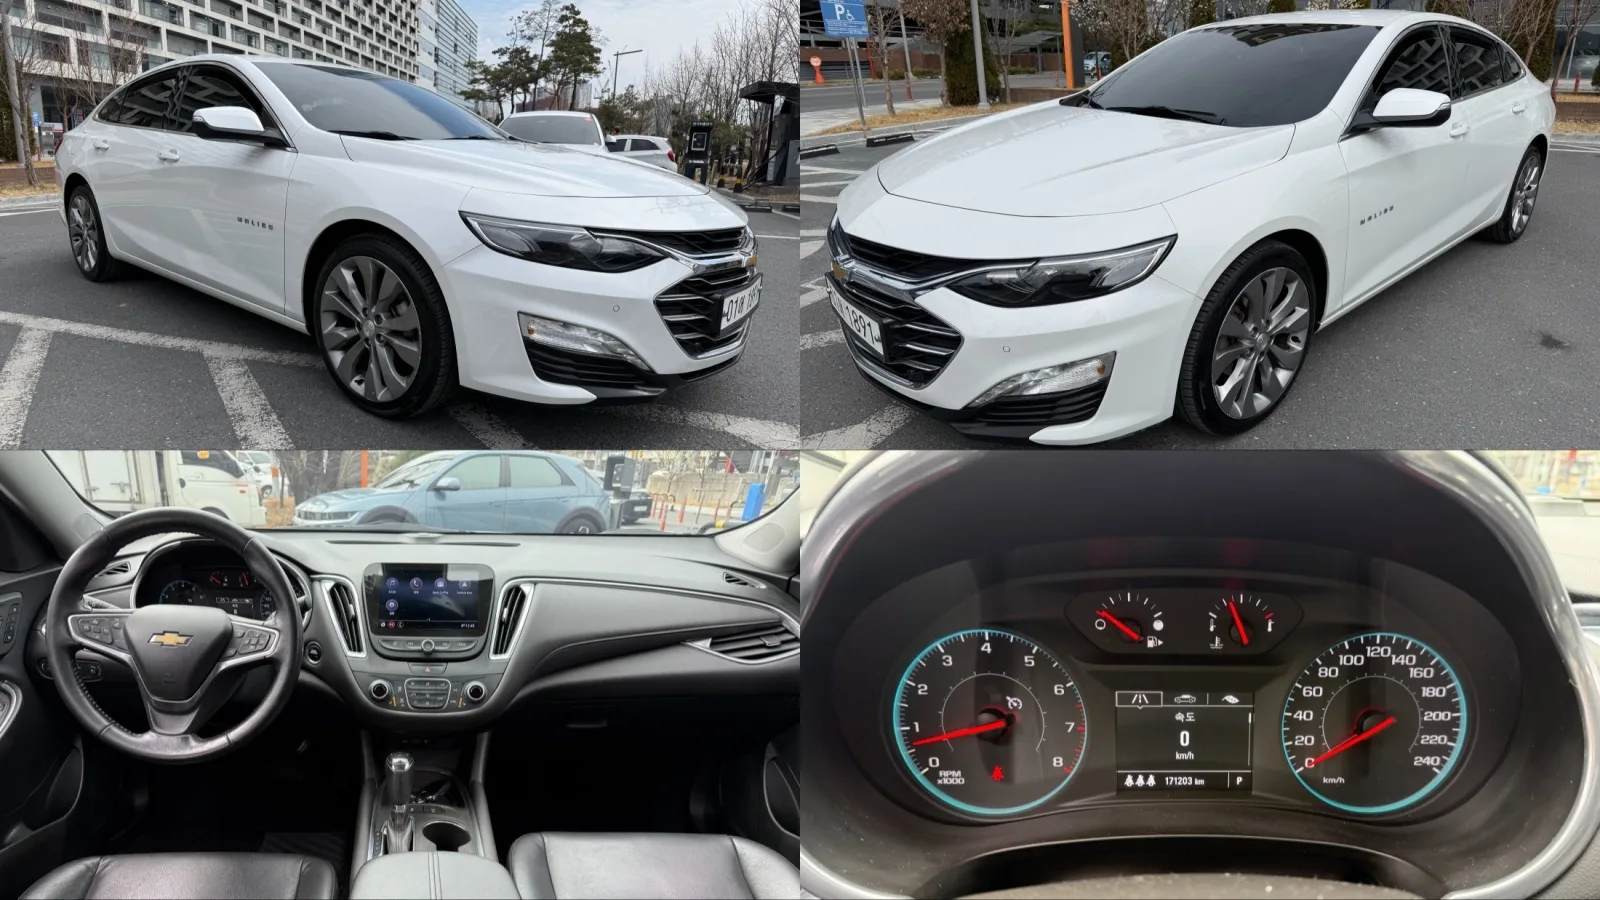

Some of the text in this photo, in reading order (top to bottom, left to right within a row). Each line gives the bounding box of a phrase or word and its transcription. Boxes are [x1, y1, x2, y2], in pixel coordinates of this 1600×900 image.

[834, 4, 845, 20] P
[981, 643, 992, 654] 4
[1366, 646, 1391, 657] 120
[942, 655, 953, 667] 3
[1024, 655, 1035, 667] 5
[1339, 655, 1364, 666] 100
[1391, 655, 1416, 666] 140
[1318, 667, 1339, 678] 80
[1409, 667, 1434, 679] 160
[917, 684, 929, 695] 2
[1053, 684, 1065, 696] 6
[1302, 686, 1323, 697] 60
[1421, 686, 1446, 697] 180
[1175, 712, 1196, 723] 속도
[1293, 710, 1313, 721] 40
[1424, 711, 1451, 721] 200
[913, 721, 920, 732] 1
[1065, 722, 1075, 733] 7
[1179, 730, 1190, 747] 0
[1294, 735, 1315, 746] 20
[1420, 735, 1447, 745] 220
[1175, 751, 1195, 760] km/h
[1414, 756, 1441, 766] 240
[928, 757, 940, 767] 0
[1053, 756, 1064, 767] 8
[1304, 758, 1315, 768] 0
[939, 770, 961, 778] RPM
[937, 777, 965, 785] x1000
[1164, 777, 1205, 786] 171203 km
[1236, 777, 1243, 785] P
[1323, 776, 1345, 784] km/h
